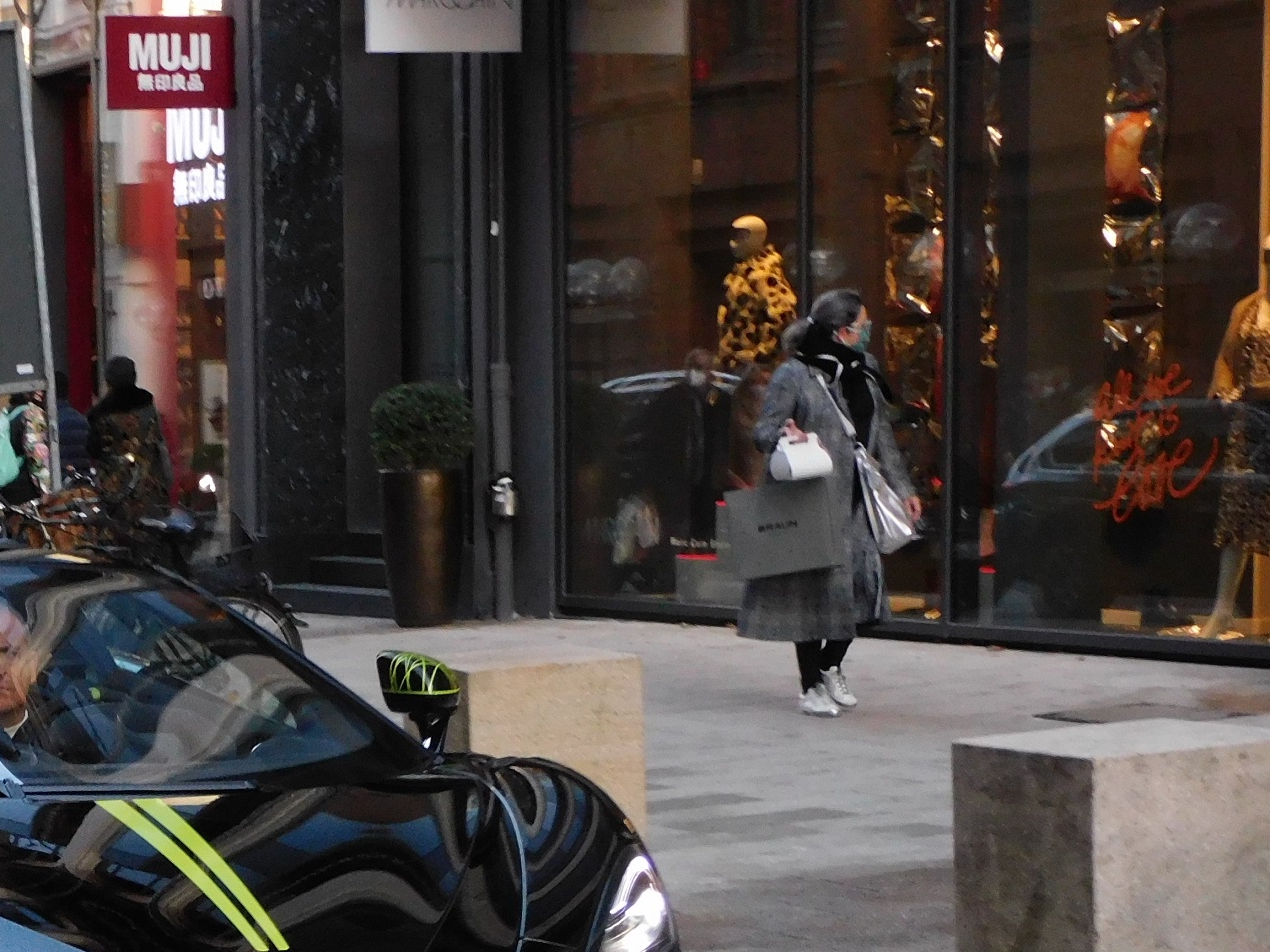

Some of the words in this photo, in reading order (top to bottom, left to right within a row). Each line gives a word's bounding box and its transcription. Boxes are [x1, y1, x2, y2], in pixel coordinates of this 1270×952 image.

[128, 33, 211, 71] MUJI
[136, 73, 205, 91] 無印良品
